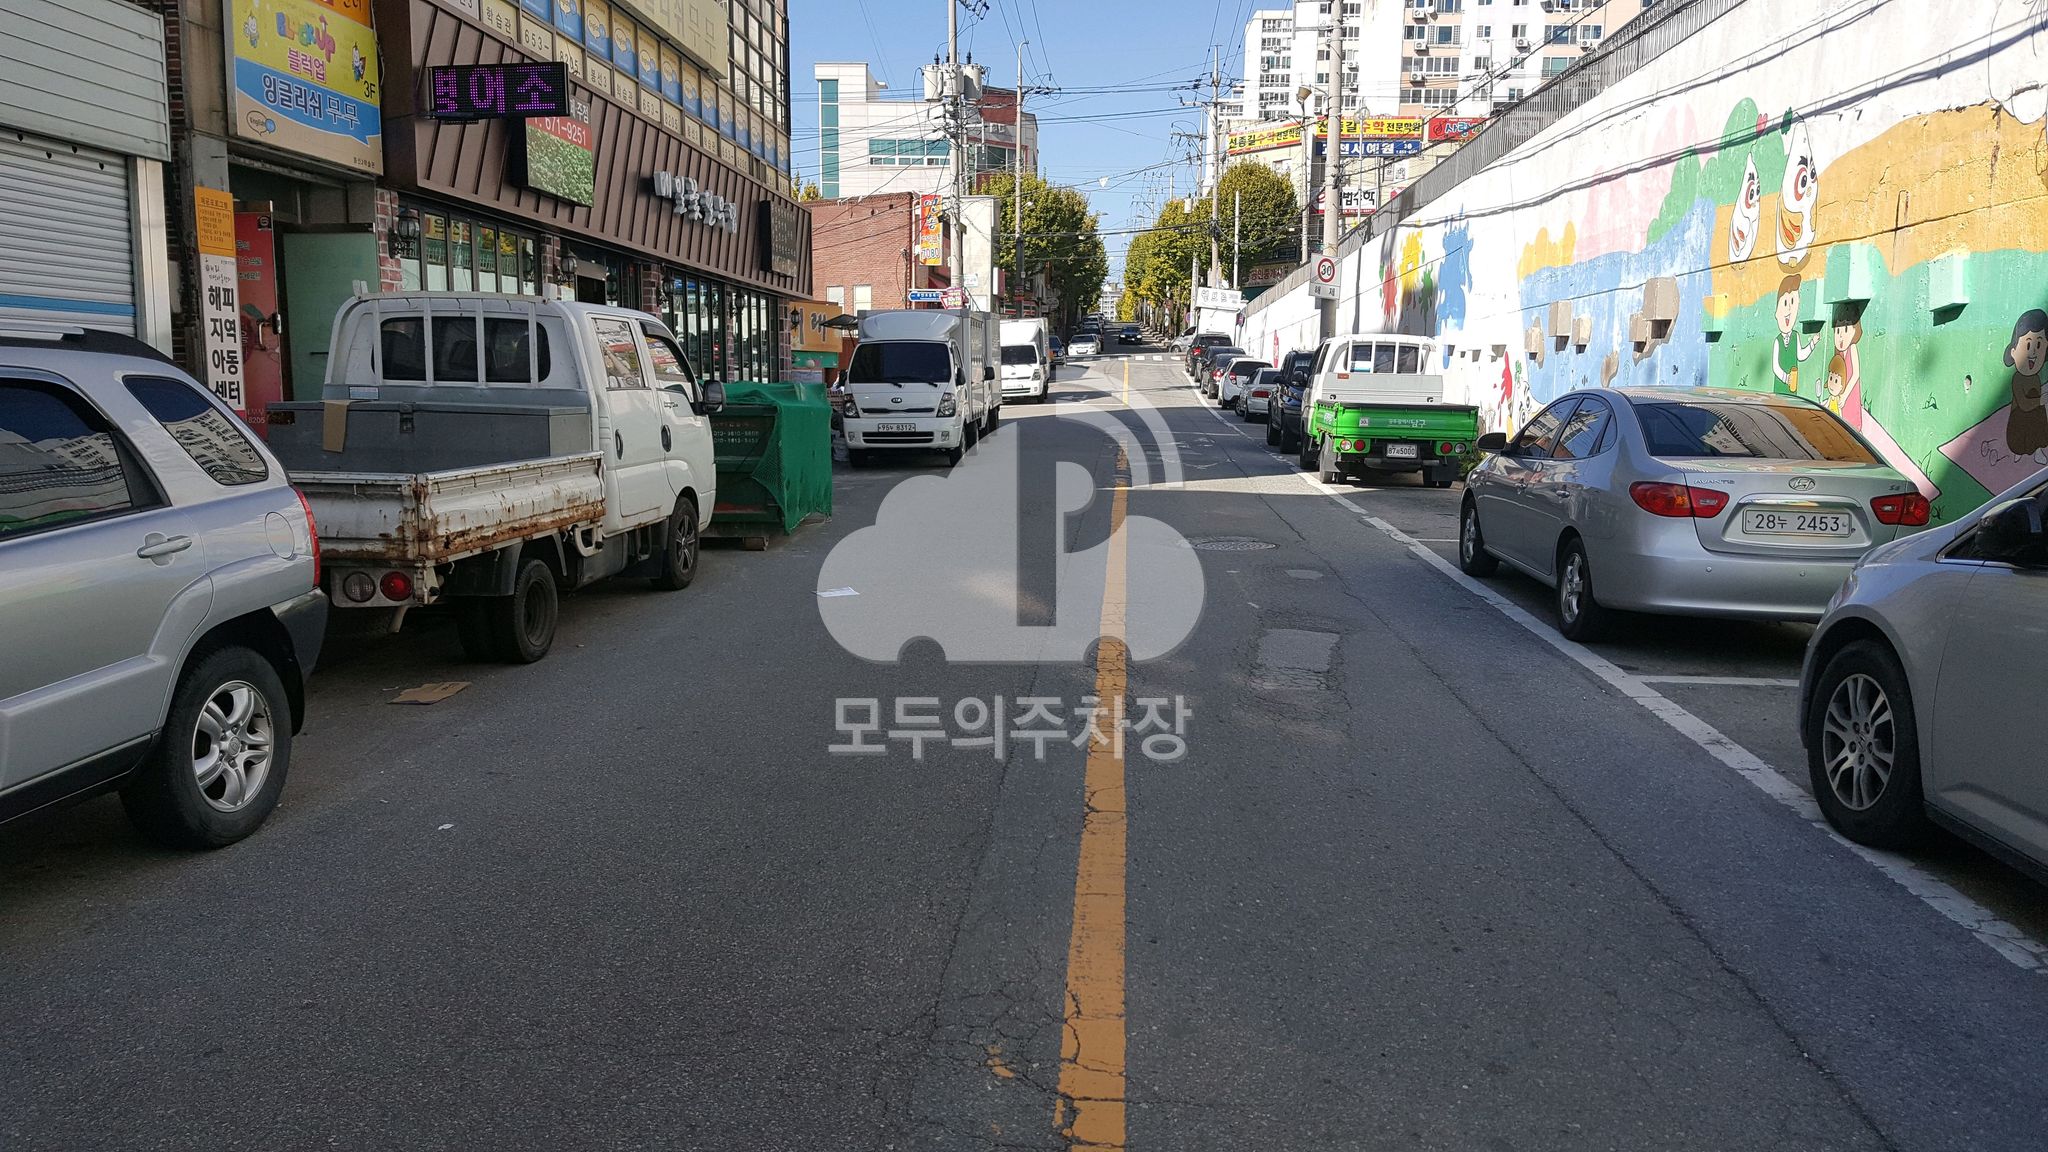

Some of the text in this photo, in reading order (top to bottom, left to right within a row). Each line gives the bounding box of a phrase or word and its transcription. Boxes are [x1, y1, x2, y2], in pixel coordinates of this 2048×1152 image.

[486, 6, 512, 35] 학습관
[524, 29, 550, 51] 653-
[288, 47, 326, 84] 블럭업
[262, 73, 361, 130] 잉글리쉬 무무
[363, 80, 376, 99] 3F
[545, 117, 586, 146] 671-9251
[1321, 265, 1332, 276] 30
[208, 285, 235, 312] 해피
[210, 318, 237, 343] 지역
[212, 349, 239, 375] 아동
[1755, 513, 1841, 532] 28누 2453
